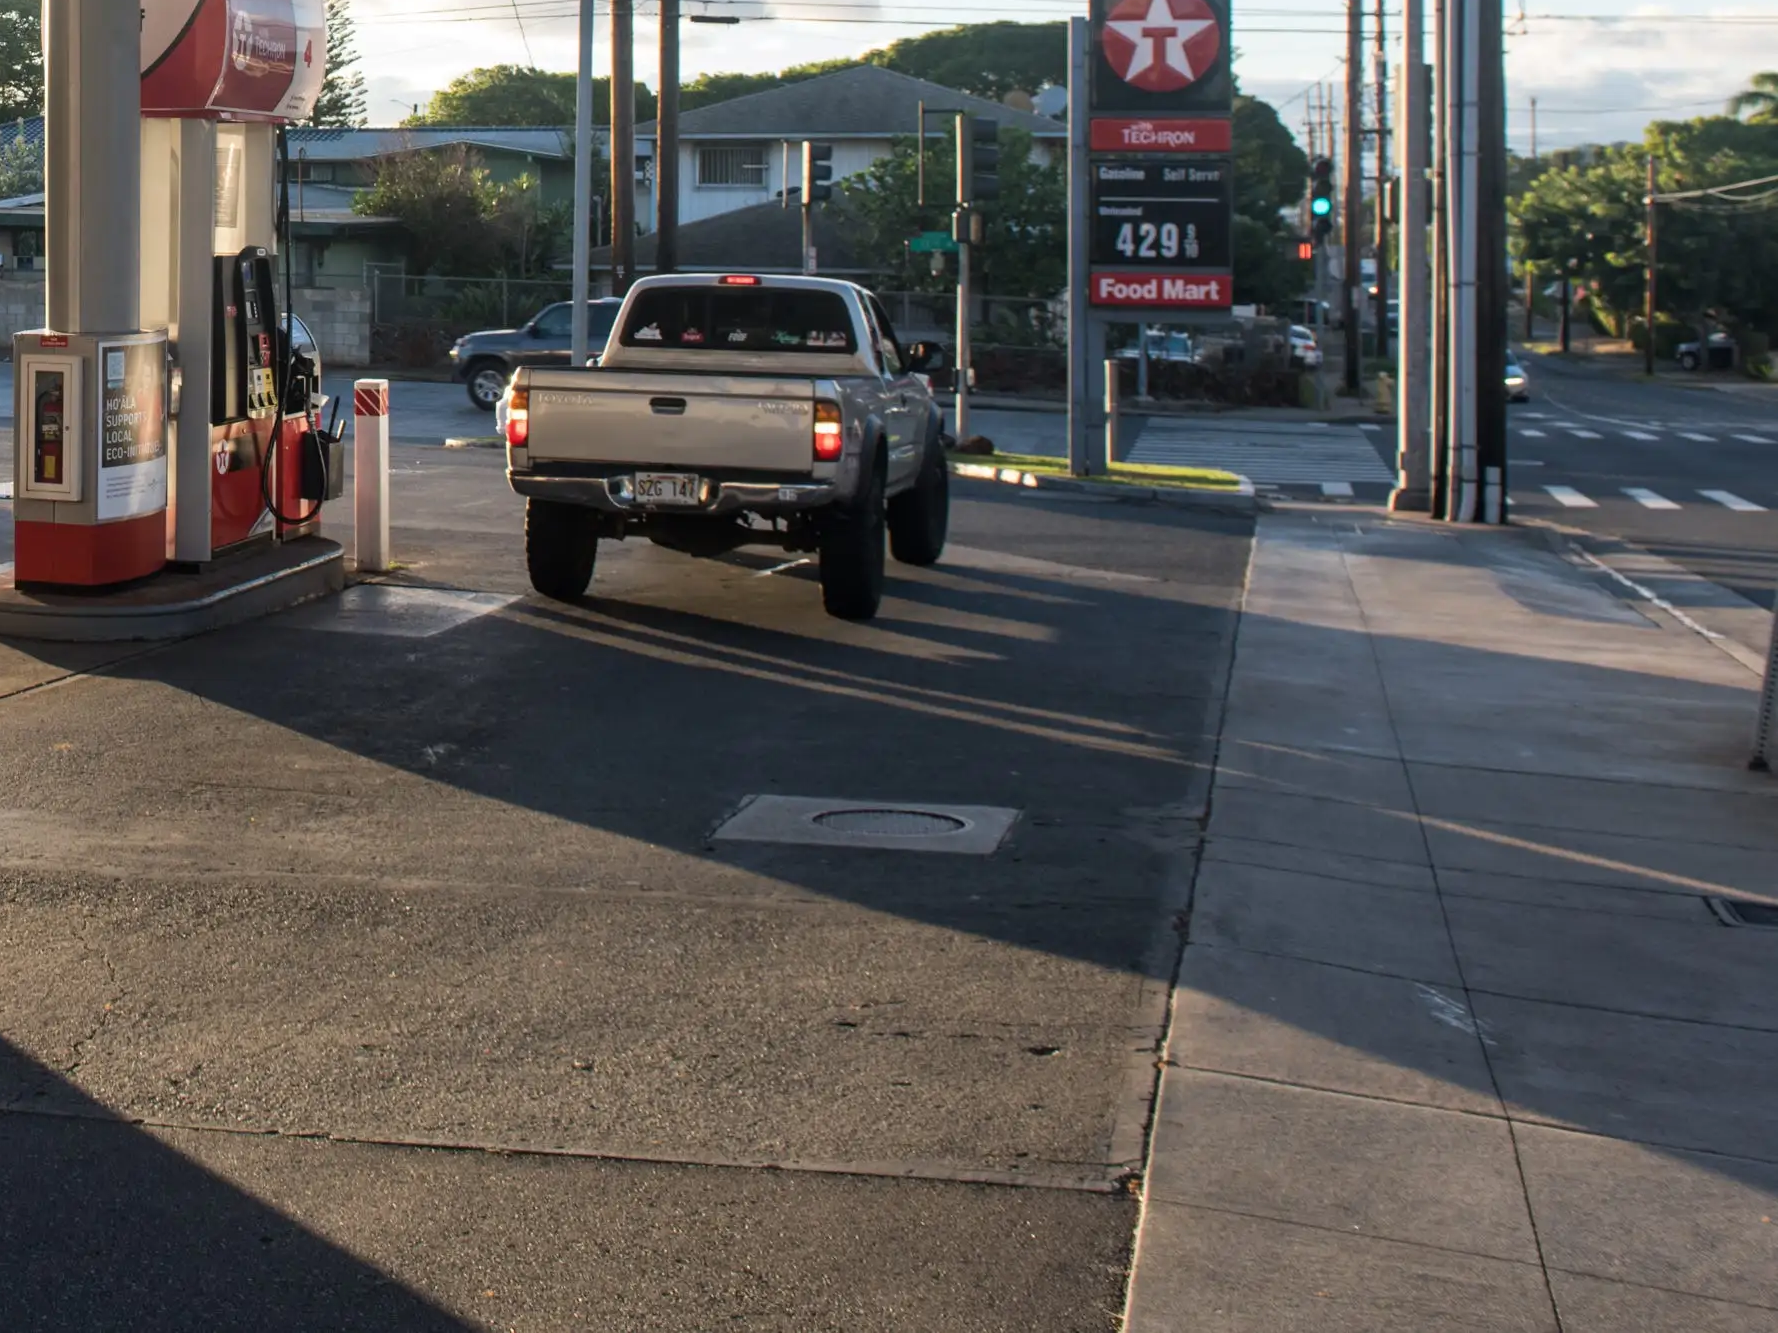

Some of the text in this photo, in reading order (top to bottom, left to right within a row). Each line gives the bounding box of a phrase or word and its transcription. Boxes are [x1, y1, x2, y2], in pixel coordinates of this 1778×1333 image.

[303, 39, 313, 68] 4
[1130, 121, 1154, 131] with
[1121, 128, 1196, 147] TECHRON
[1163, 168, 1186, 181] Self
[1188, 168, 1221, 182] Serve
[1115, 222, 1180, 258] 429
[1099, 278, 1220, 301] Food Mart
[106, 429, 133, 444] LOCAL
